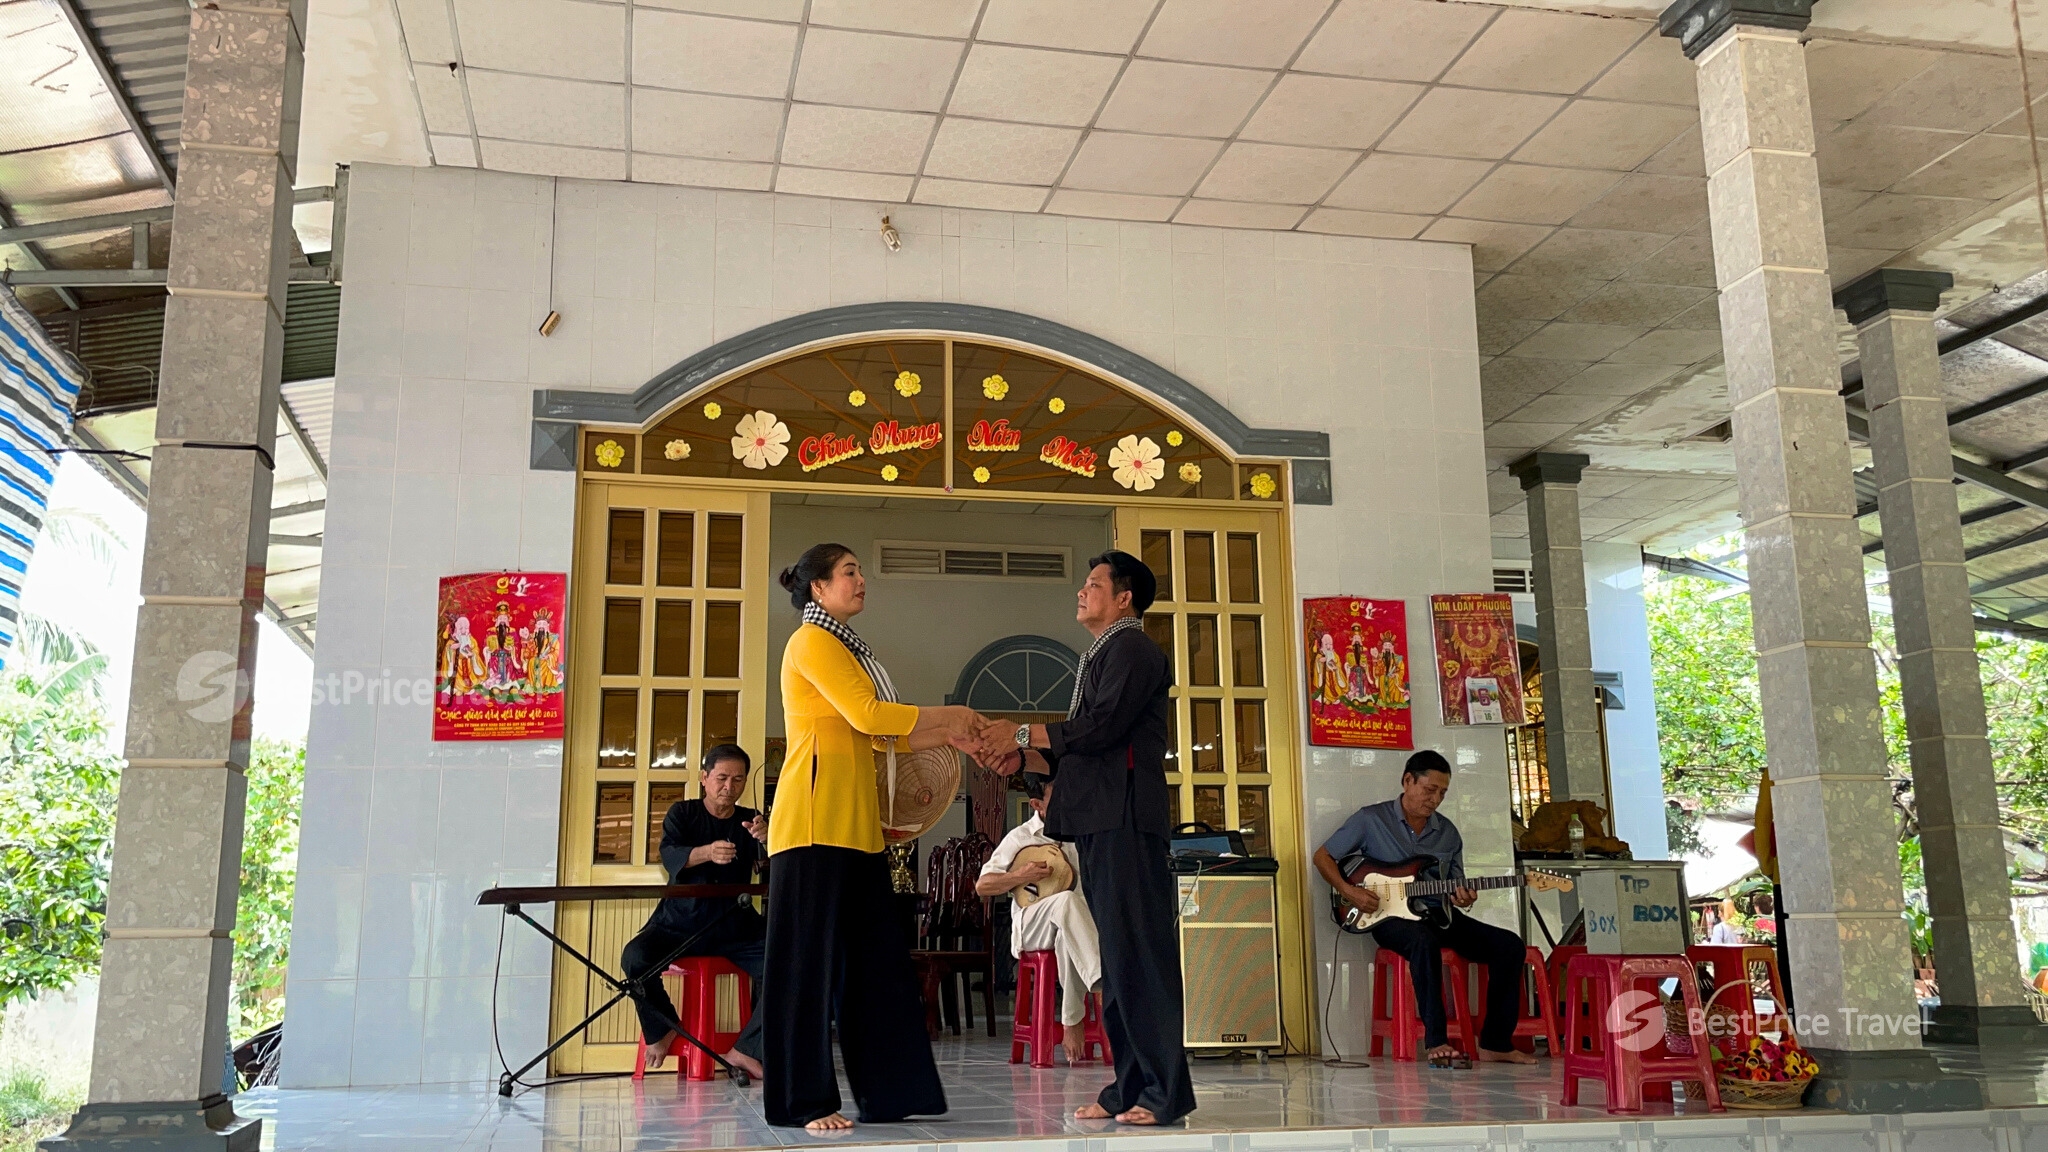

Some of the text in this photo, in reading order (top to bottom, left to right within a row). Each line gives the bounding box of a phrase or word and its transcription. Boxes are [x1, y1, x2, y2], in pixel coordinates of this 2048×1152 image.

[1433, 602, 1450, 612] KIM
[1452, 601, 1474, 611] LOAN
[1478, 688, 1491, 707] 6
[1619, 874, 1650, 894] TIP
[1633, 904, 1679, 922] BOX
